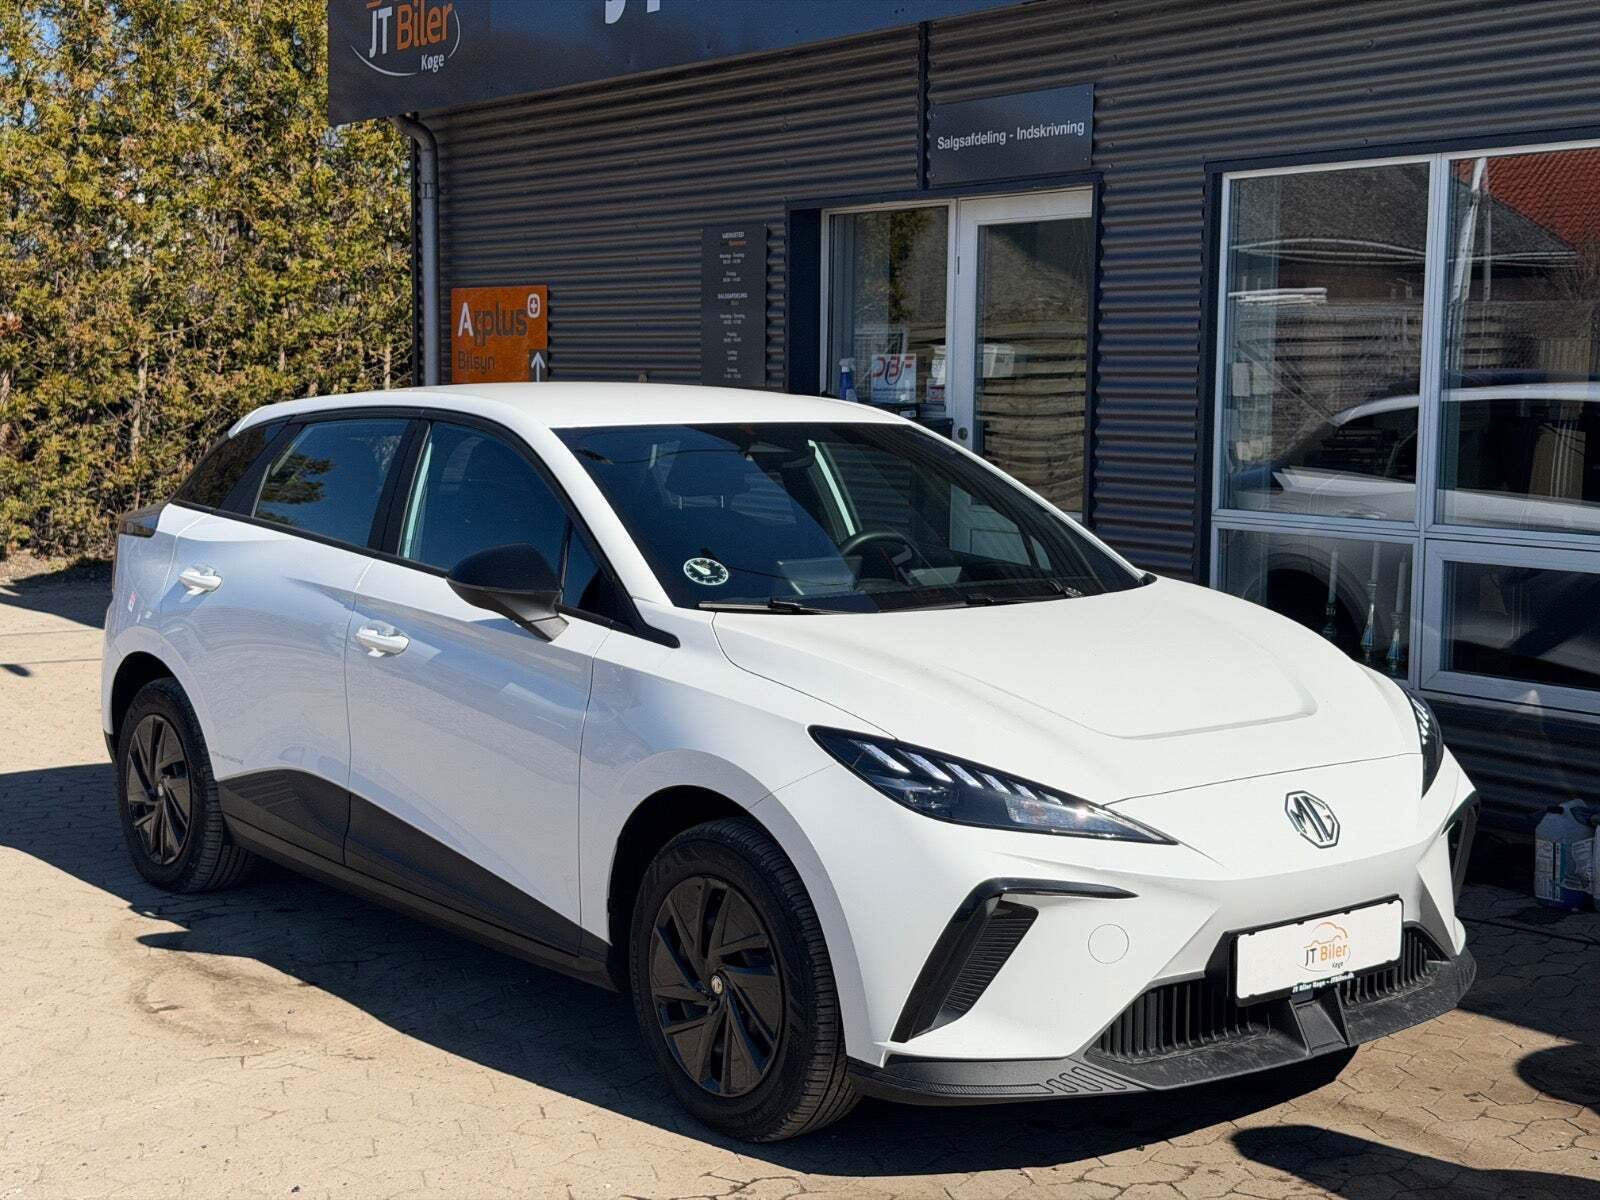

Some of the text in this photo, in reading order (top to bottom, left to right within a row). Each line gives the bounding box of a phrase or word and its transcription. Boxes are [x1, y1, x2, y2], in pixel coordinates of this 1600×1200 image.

[369, 0, 453, 58] JT Biler
[421, 54, 445, 73] Køge
[937, 130, 1007, 151] Salgsafdeling
[1016, 120, 1085, 140] Indskrivning
[458, 351, 496, 374] Bilsyn
[1290, 796, 1335, 842] MG
[1305, 943, 1348, 966] JT Biler
